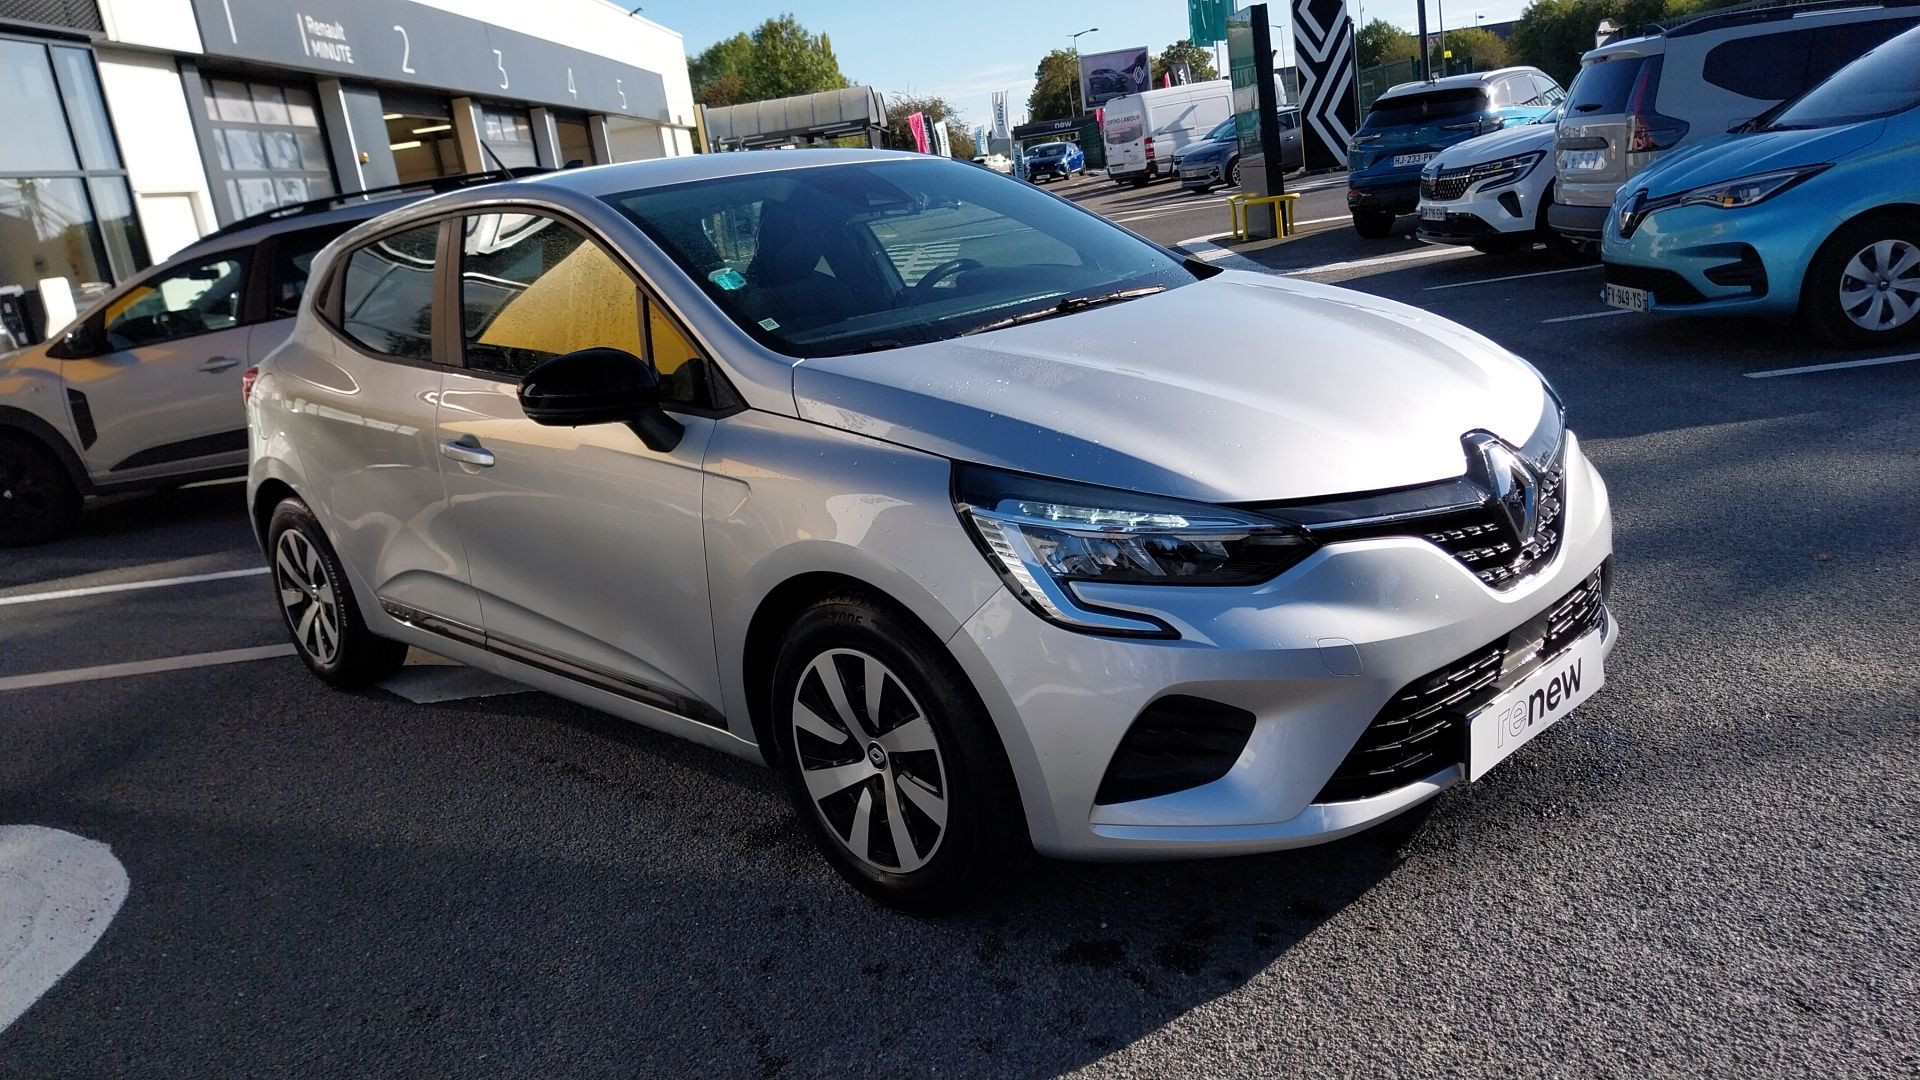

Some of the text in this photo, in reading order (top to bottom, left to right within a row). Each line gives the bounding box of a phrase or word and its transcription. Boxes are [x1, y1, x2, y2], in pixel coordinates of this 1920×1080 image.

[304, 15, 346, 40] Renault
[310, 39, 354, 64] MINUTE
[393, 25, 416, 74] 2
[493, 49, 508, 89] 3
[567, 68, 577, 100] 4
[616, 78, 627, 110] 5
[1054, 121, 1072, 129] new
[1497, 657, 1582, 748] renew
